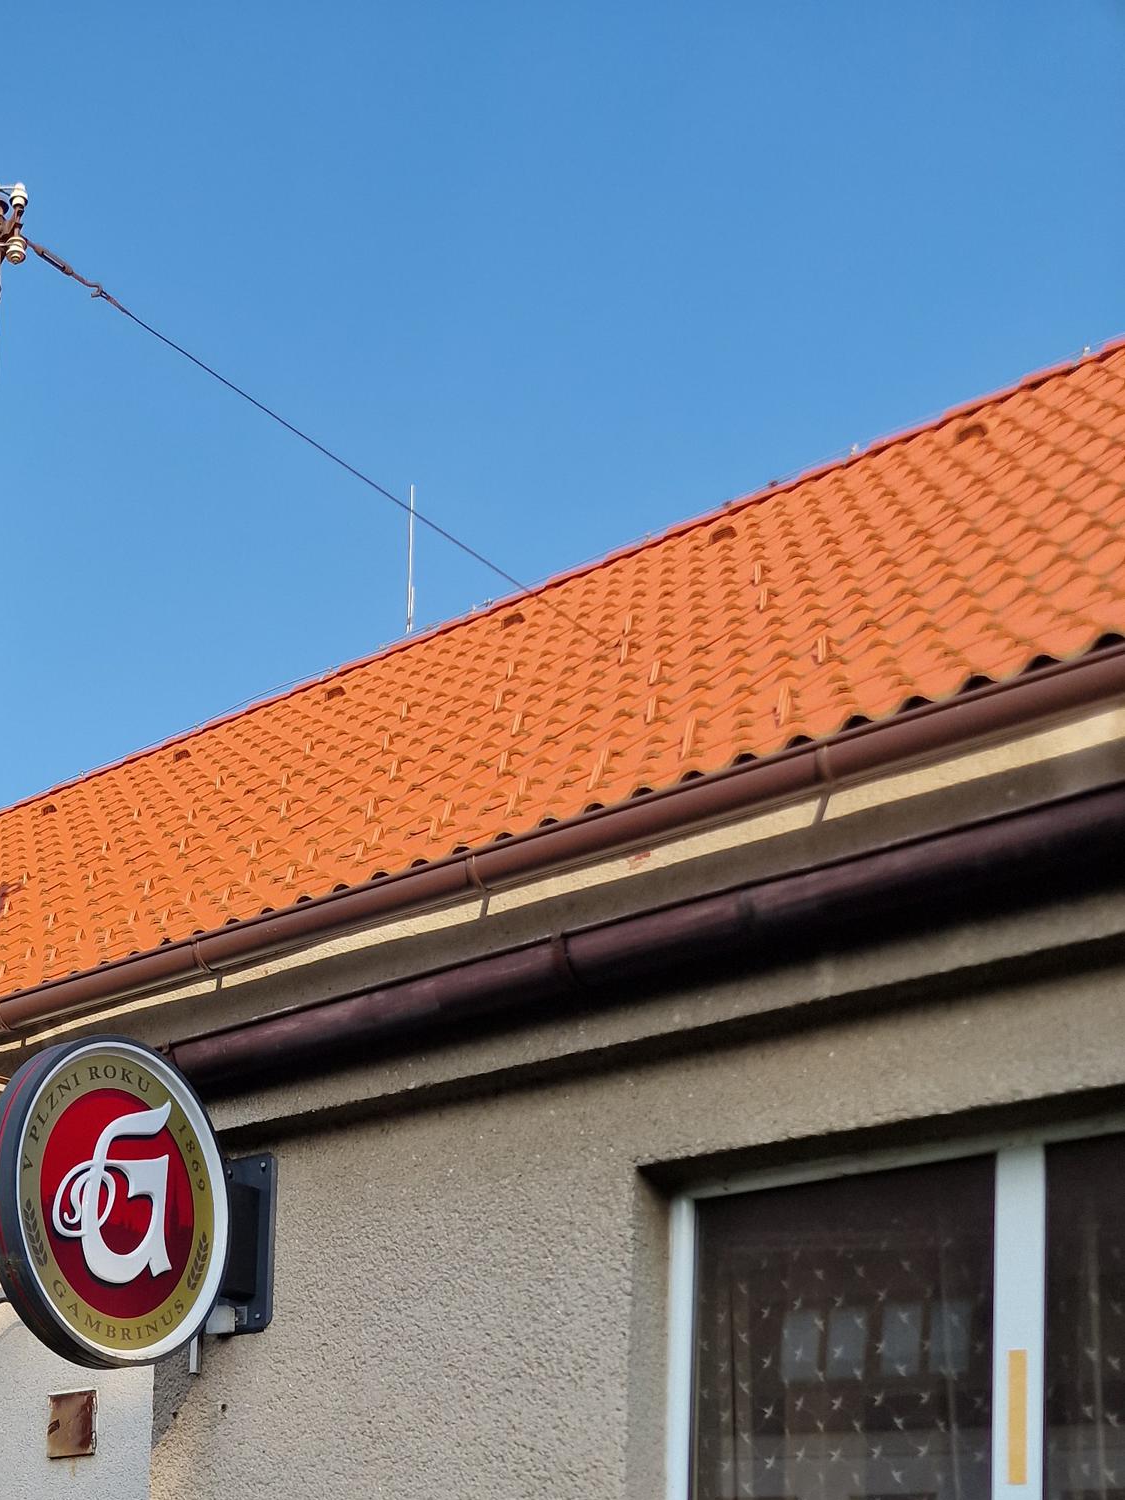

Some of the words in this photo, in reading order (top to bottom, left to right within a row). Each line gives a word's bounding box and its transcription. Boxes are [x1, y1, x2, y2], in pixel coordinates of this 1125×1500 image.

[22, 1155, 35, 1172] V
[29, 1072, 81, 1144] PLZNI
[88, 1065, 151, 1093] ROKU
[178, 1124, 205, 1192] 1869
[52, 1279, 184, 1342] GAMBRINUS
